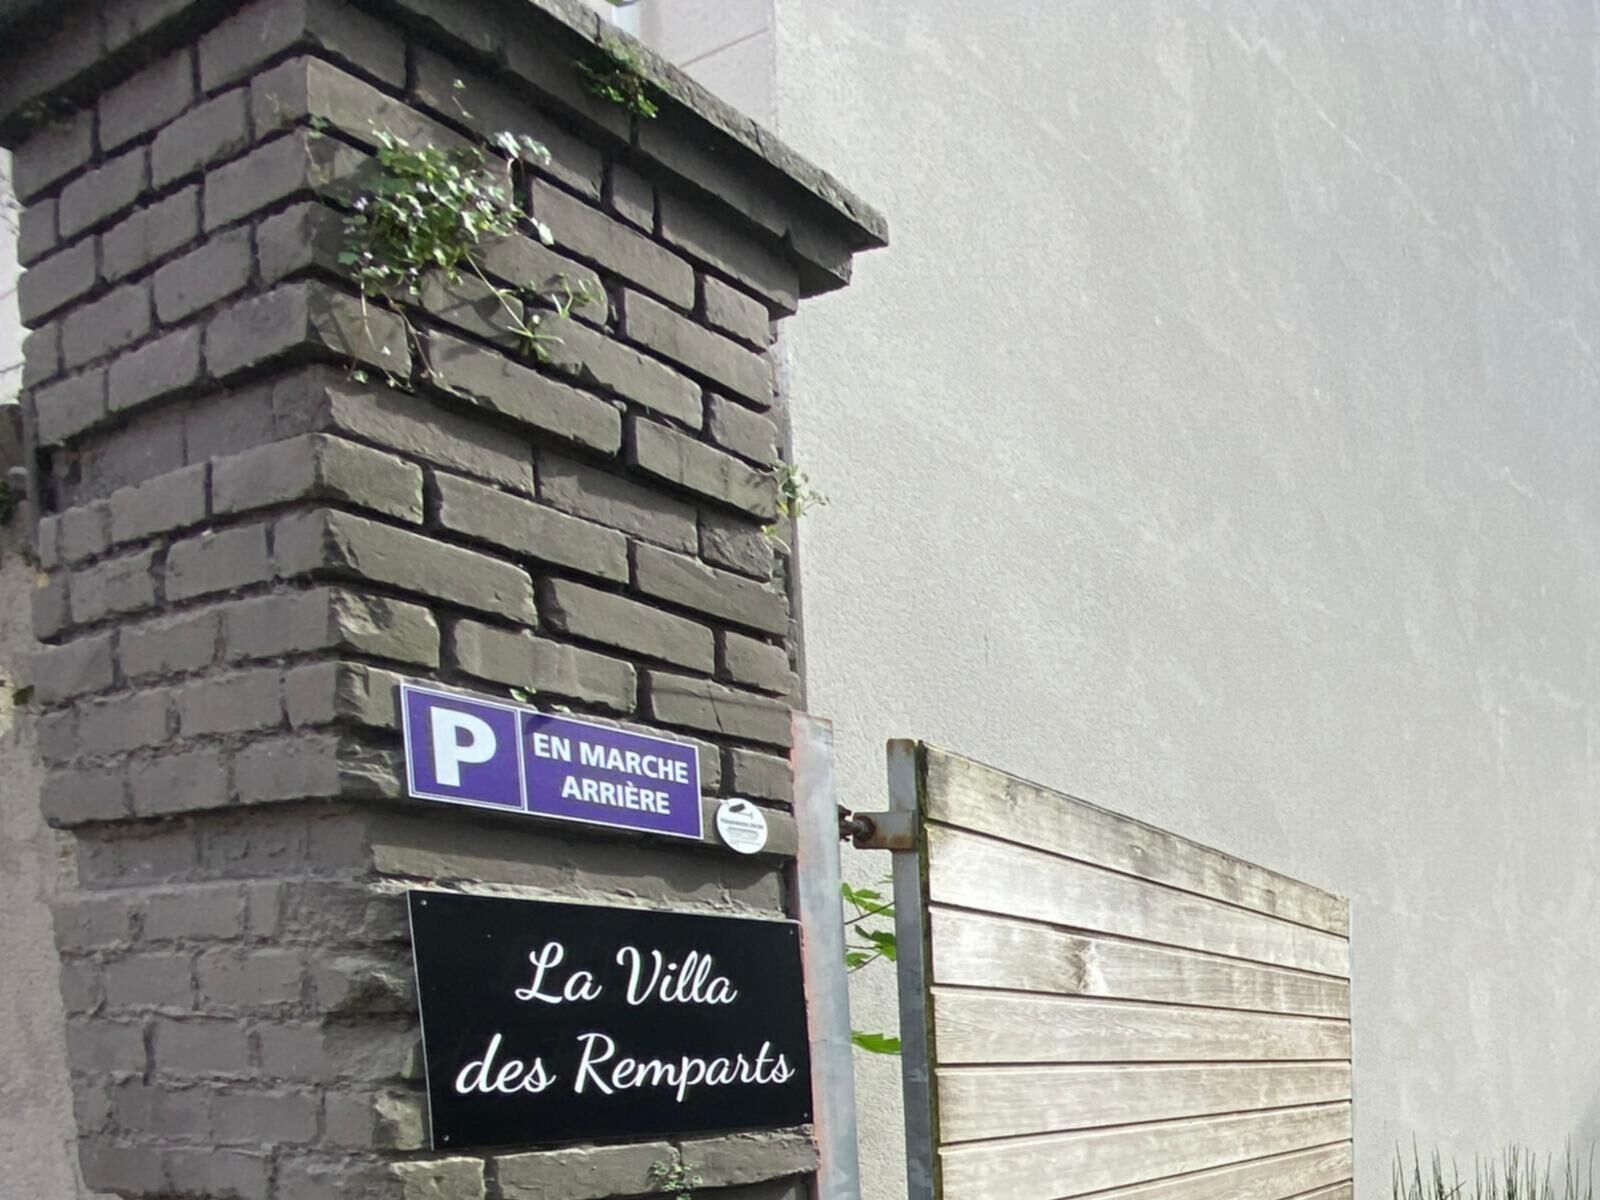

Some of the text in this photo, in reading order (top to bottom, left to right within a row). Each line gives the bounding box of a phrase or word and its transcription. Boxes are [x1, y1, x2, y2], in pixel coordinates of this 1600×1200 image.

[429, 705, 497, 787] P
[532, 731, 690, 785] EN MARCHE
[561, 775, 671, 815] ARRIÈRE
[514, 941, 738, 1006] La Villa
[455, 1032, 796, 1103] des Remparts
